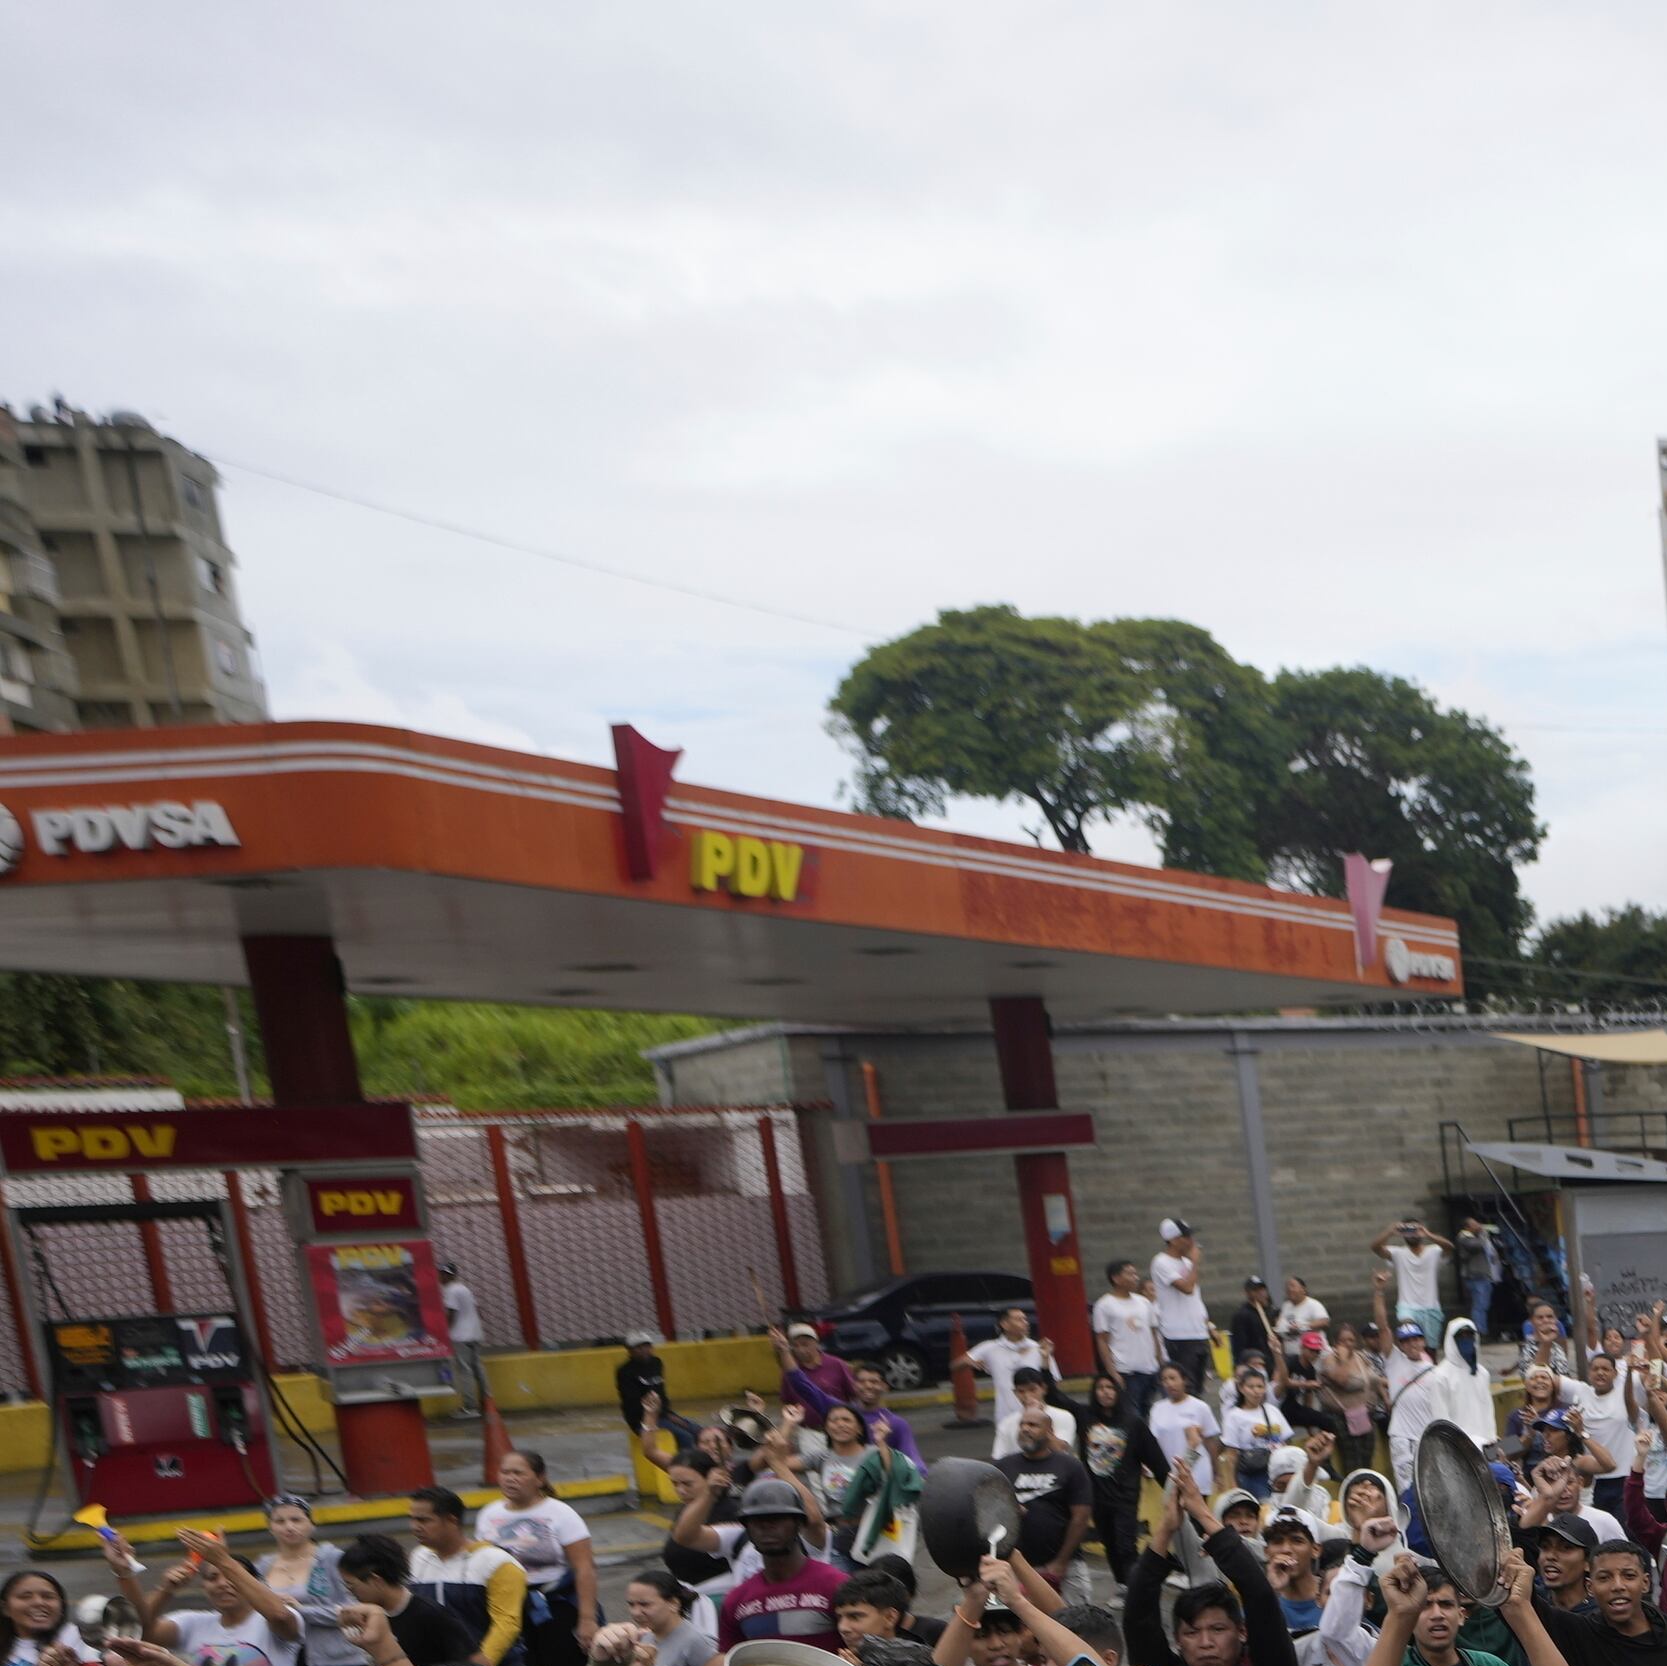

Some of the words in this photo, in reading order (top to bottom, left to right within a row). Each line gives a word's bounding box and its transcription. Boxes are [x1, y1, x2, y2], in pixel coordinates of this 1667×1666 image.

[32, 800, 241, 857] PDVSA
[694, 831, 803, 901] PDV
[30, 1124, 177, 1161] PDV
[318, 1190, 404, 1217] PDV
